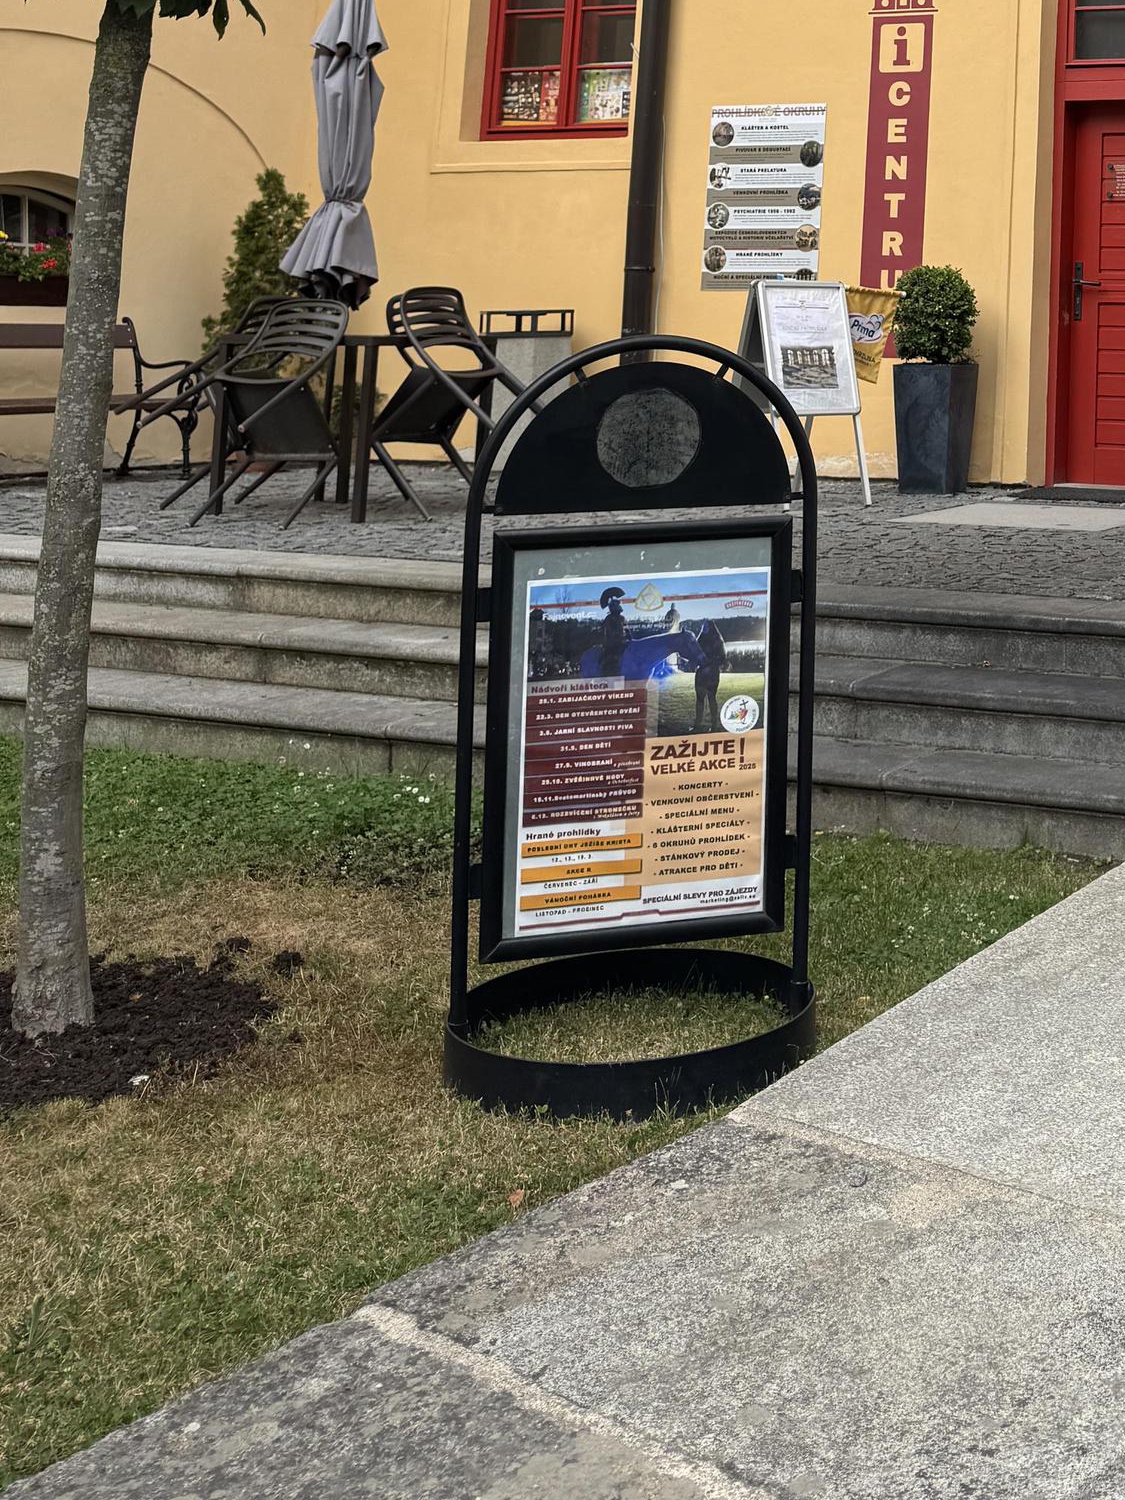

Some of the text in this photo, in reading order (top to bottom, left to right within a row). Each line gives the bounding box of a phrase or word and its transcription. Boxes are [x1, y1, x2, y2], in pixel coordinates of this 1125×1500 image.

[880, 81, 911, 290] CENTRU
[850, 319, 876, 338] Prima
[531, 681, 609, 694] Nádvoří kláštera
[558, 693, 606, 703] ZABIJAČKOVÝ
[608, 692, 634, 700] VÍKEND
[571, 707, 618, 718] OTEVŘENÝCH
[554, 727, 575, 735] JARNÍ
[577, 724, 616, 733] SLAVNOSTI
[617, 723, 634, 731] PIVA
[595, 741, 611, 749] DĚTÍ
[650, 739, 735, 760] ZAŽIJTE
[574, 758, 613, 768] VINOBRANÍ
[651, 758, 756, 775] VELKÉ AKCE 2025
[678, 781, 723, 791] KONCERTY
[651, 790, 754, 806] VENKOVNÍ OBČERSTVENÍ
[664, 807, 735, 820] SPECIÁLNÍ MENU
[656, 819, 745, 834] KLÁŠTERNÍ SPECIÁLY
[526, 828, 602, 840] Hrané prohlídky
[660, 837, 696, 847] OKRUHŮ
[698, 833, 745, 844] PROHLÍDEK
[527, 842, 562, 853] POSLEDNÍ
[606, 838, 631, 846] KRISTA
[660, 848, 740, 861] STÁNKOVÝ PRODEJ
[659, 866, 697, 876] ATRAKCE
[700, 864, 716, 872] PRO
[543, 880, 577, 889] ČERVENEC
[578, 891, 611, 901] POHÁDKA
[642, 886, 758, 904] SPECIÁLNÍ SLEVY PRO ZÁJEZDY
[535, 908, 567, 917] LISTOPAD
[572, 905, 605, 913] PROSINEC
